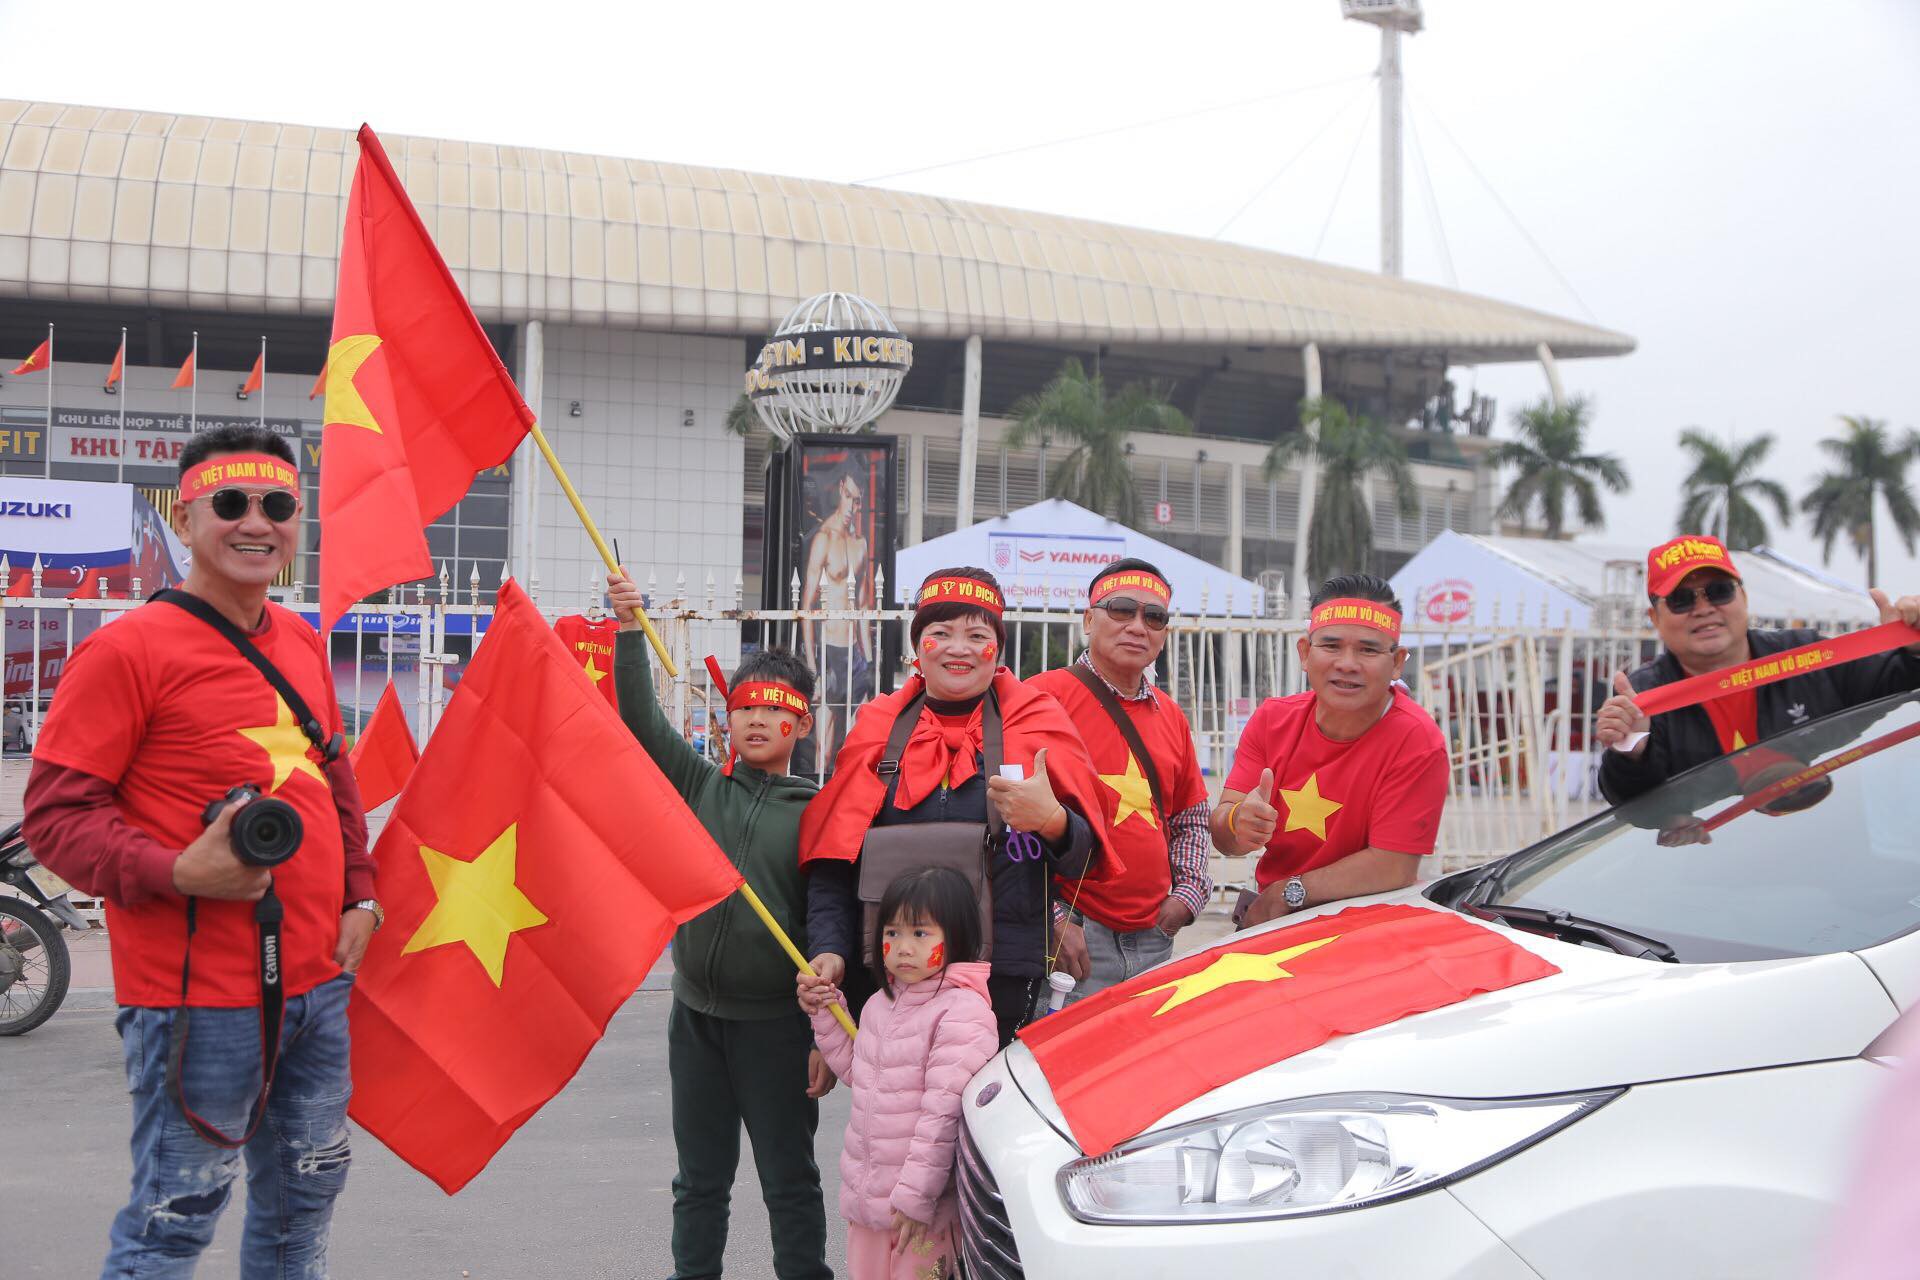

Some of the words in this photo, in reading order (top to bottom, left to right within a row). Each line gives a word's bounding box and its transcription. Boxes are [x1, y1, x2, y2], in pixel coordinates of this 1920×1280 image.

[58, 413, 88, 426] KHU
[92, 413, 121, 427] LIÊN
[126, 416, 154, 431] HỢP
[158, 415, 185, 431] THỂ
[271, 423, 295, 434] GIA
[70, 437, 126, 456] KHU
[135, 437, 184, 462] TẬP
[201, 465, 223, 485] VIỆT
[227, 462, 257, 478] NAM
[258, 462, 274, 480] VÔ
[276, 466, 294, 487] ĐỊCH
[1157, 502, 1171, 521] B
[922, 584, 939, 599] NAM
[959, 581, 973, 596] VÔ
[975, 586, 995, 604] ĐỊCH
[1103, 577, 1118, 591] VIỆT
[1120, 575, 1140, 586] NAM
[1142, 576, 1153, 588] VÔ
[351, 616, 383, 624] GAND
[1320, 606, 1333, 622] VIỆT
[1334, 605, 1358, 618] NAM
[1360, 606, 1372, 621] VÔ
[1374, 610, 1392, 629] ĐỊCH
[1730, 669, 1752, 687] VIỆT
[1755, 662, 1780, 680] NAM
[1780, 655, 1795, 672] VÔ
[1795, 649, 1822, 670] ĐỊCH
[763, 687, 785, 704] VIỆT
[787, 692, 804, 711] NAM
[265, 935, 278, 985] Canon
